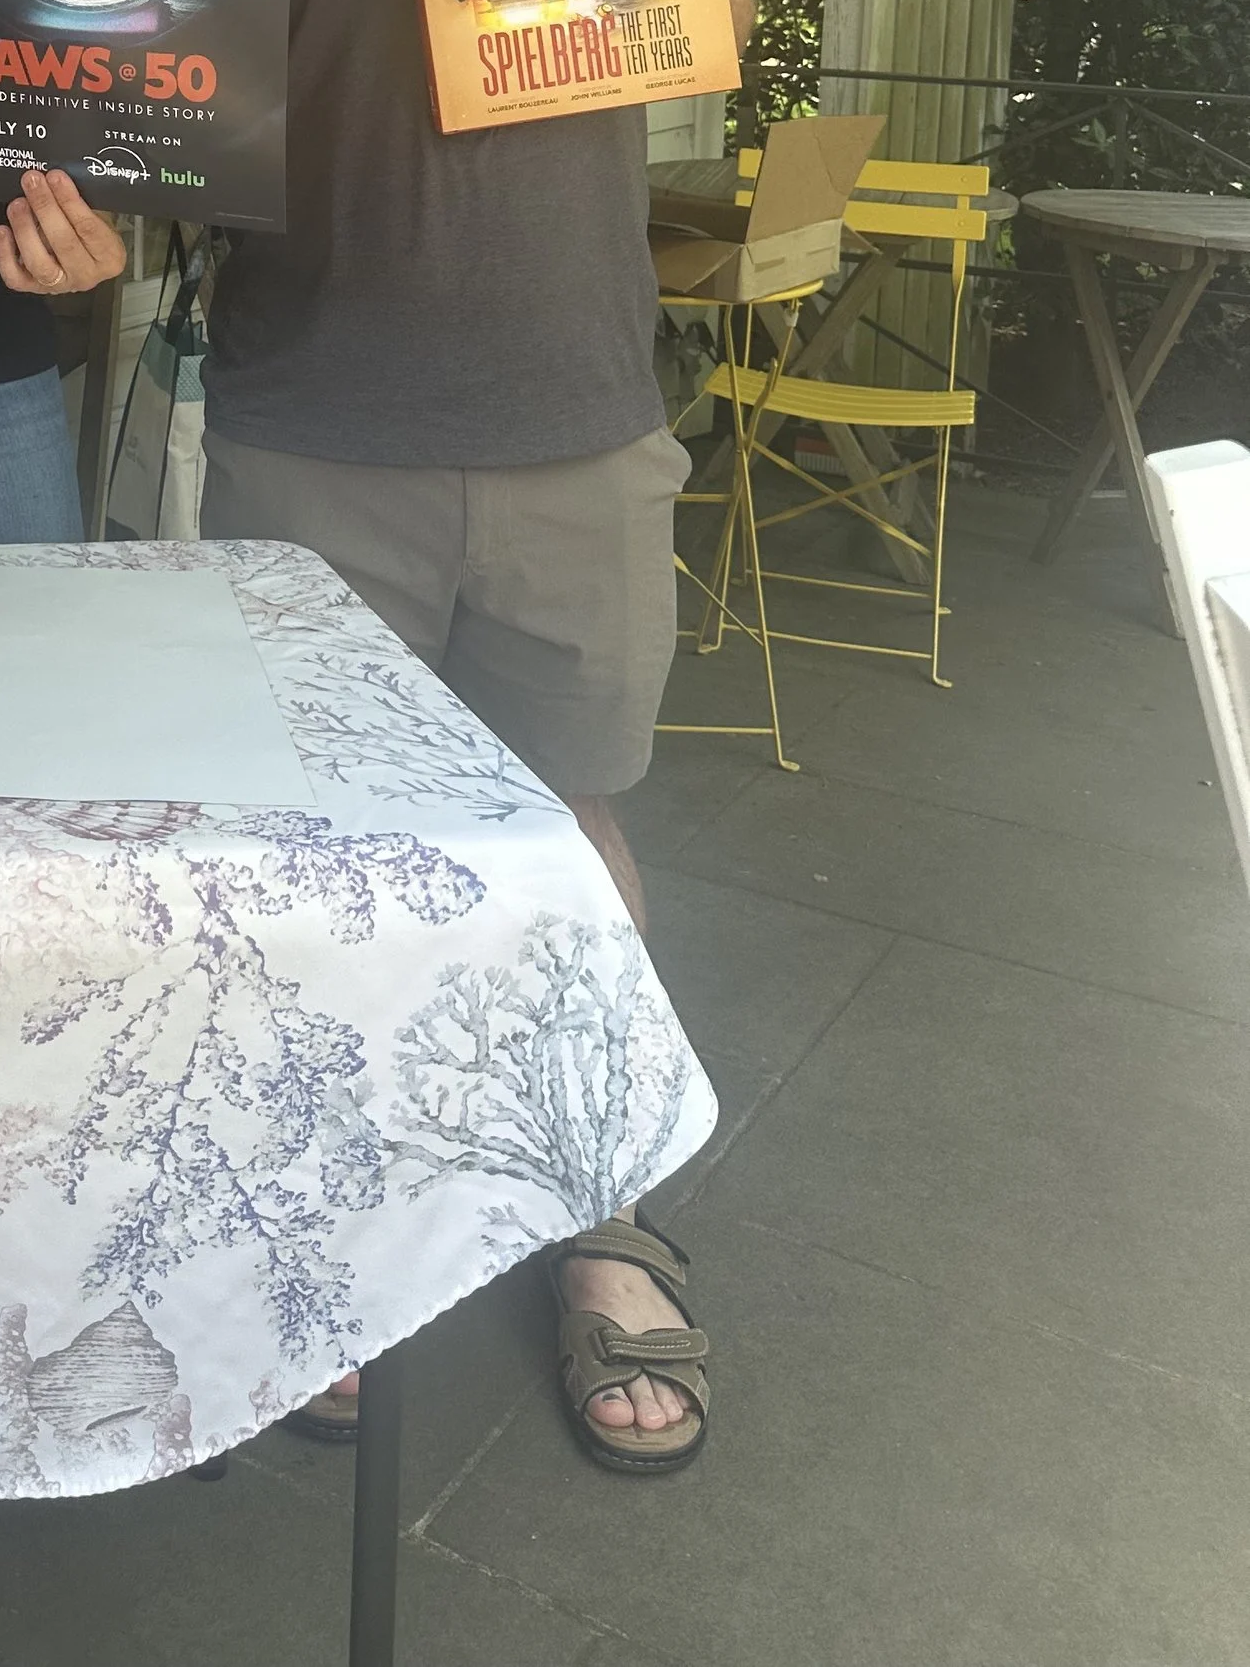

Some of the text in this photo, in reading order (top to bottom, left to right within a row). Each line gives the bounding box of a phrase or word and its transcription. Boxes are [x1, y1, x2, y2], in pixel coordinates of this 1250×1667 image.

[618, 4, 682, 44] THE FIRST
[477, 14, 623, 97] SPIELBERG
[623, 36, 694, 75] TEN YEARS
[119, 63, 137, 82] @
[144, 51, 218, 103] 50
[645, 81, 673, 90] GEORGE
[674, 76, 696, 85] LUCAS
[570, 93, 590, 101] JOHN
[590, 88, 623, 98] WILLIAMS
[98, 100, 154, 117] INSIDE
[162, 107, 216, 122] STORY
[487, 103, 518, 114] LAURENT
[519, 97, 559, 109] BOUZEREAU
[25, 124, 48, 139] 10
[104, 130, 182, 147] STREAM ON
[160, 167, 206, 187] hulu
